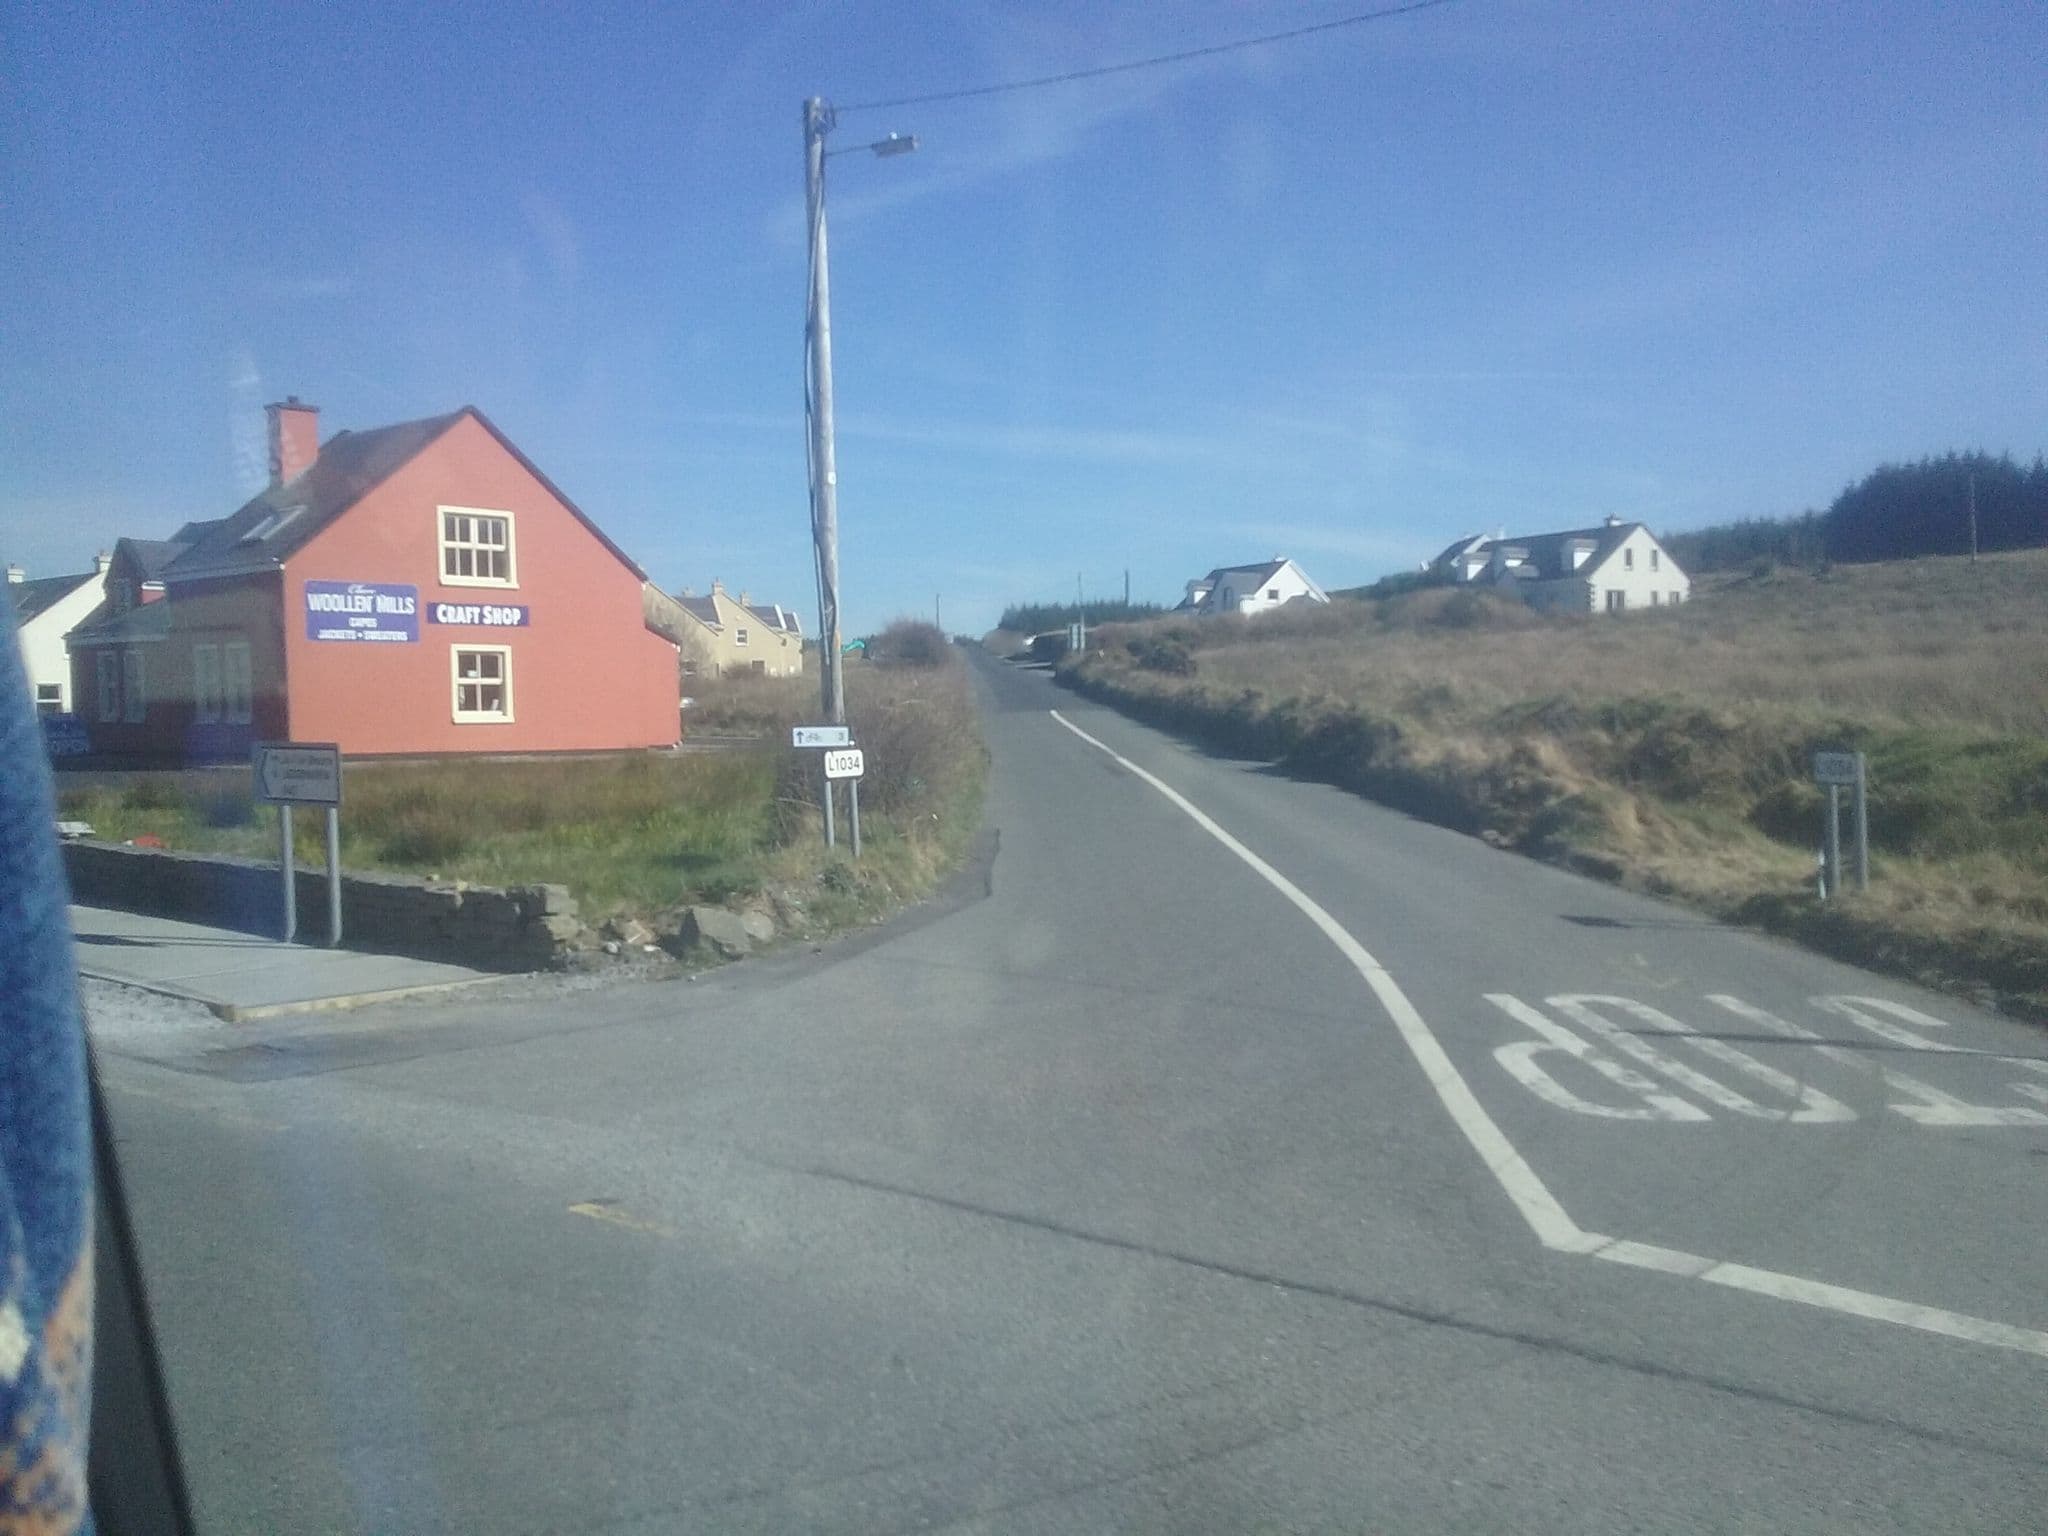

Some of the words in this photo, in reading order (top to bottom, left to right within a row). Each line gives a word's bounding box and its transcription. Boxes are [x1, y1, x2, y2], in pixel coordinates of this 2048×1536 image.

[307, 593, 374, 613] WOOLLEN
[376, 594, 415, 615] MILLS
[437, 603, 480, 624] CRAFT
[482, 605, 521, 626] SHOP
[828, 756, 860, 772] L1034
